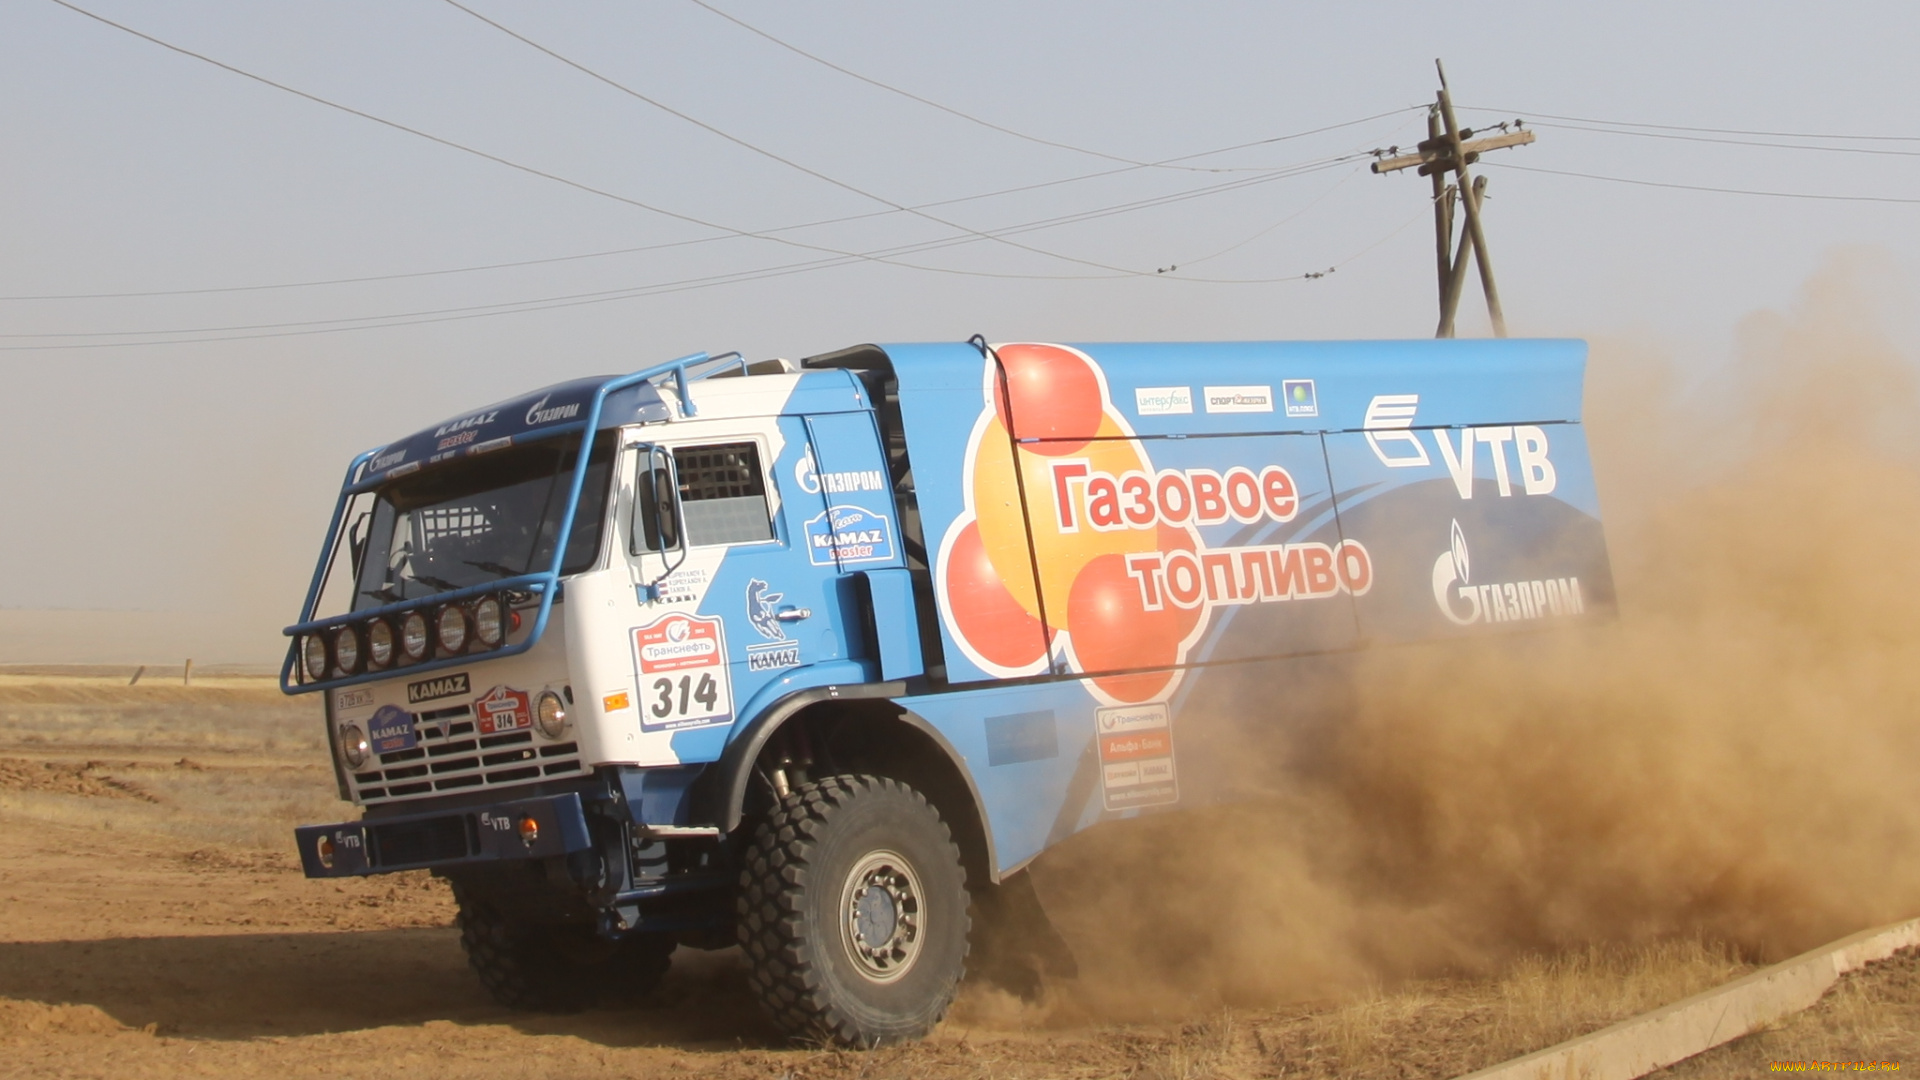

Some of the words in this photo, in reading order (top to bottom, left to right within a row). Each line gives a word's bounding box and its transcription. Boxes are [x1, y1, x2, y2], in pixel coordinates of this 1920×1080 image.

[434, 411, 498, 438] KAMAZ
[437, 430, 478, 450] master
[1433, 425, 1556, 499] VTB
[821, 471, 883, 493] ГАЗПРОМ
[1050, 461, 1298, 532] Газовое
[826, 510, 863, 529] Team
[813, 530, 883, 547] KAMAZ
[829, 546, 873, 558] master
[1127, 541, 1372, 609] топливо
[1479, 577, 1585, 623] ГАЗПРОМ
[647, 643, 711, 658] Транснефть
[750, 650, 800, 671] KAMAZ
[410, 676, 467, 701] KAMAZ
[652, 672, 717, 718] 314
[497, 713, 513, 729] 314
[372, 724, 410, 740] KAMAZ
[491, 817, 511, 830] VTB
[343, 834, 360, 847] VTB
